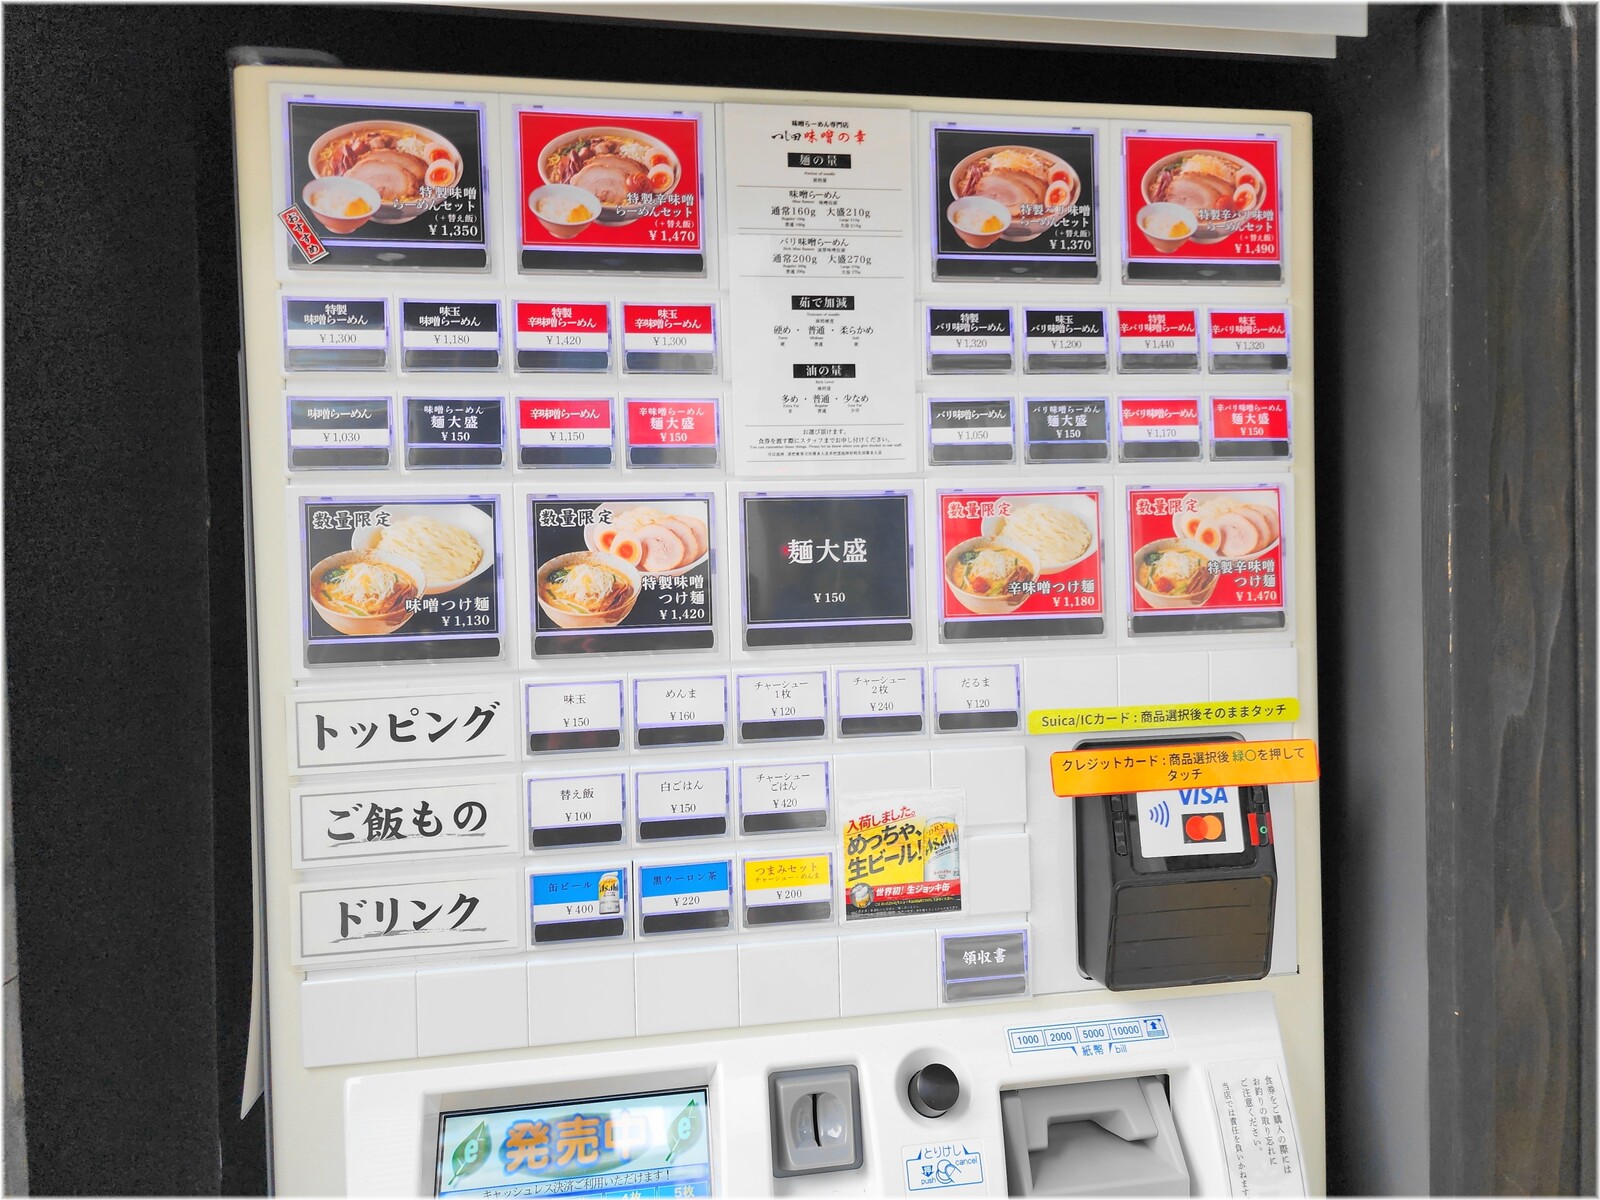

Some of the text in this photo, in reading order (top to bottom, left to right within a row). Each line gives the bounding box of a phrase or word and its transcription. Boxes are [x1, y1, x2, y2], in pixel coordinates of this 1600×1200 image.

[792, 120, 849, 128] 味噌らーめん専門店
[419, 186, 478, 200] 特製味噌
[626, 192, 694, 206] 特製辛味噌
[788, 190, 841, 199] 味噌らーめん
[392, 200, 476, 212] らーめんセット
[615, 206, 693, 218] らーめんセット
[771, 206, 870, 218] 通常160g 大盛210g
[1020, 217, 1090, 228] らーめんセット
[1207, 221, 1274, 232] らーめんセット
[287, 212, 320, 255] おすすめ
[780, 238, 849, 246] バリ味噌らーめん
[772, 254, 872, 265] 通常200g 大盛270g
[800, 296, 848, 309] 茹で加減
[325, 304, 348, 316] 特製
[439, 305, 460, 316] 味玉
[552, 307, 572, 318] 特製
[658, 309, 678, 320] 味玉
[304, 314, 368, 326] 味噌らーめん
[419, 315, 481, 326] 味噌らーめん
[528, 316, 597, 328] 辛味噌らーめん
[634, 318, 702, 330] 辛味噌らーめん
[960, 312, 979, 324] 特製
[1055, 314, 1074, 325] 味玉
[1148, 314, 1166, 324] 特製
[1238, 316, 1256, 326] 味玉
[773, 325, 874, 334] 硬め 普通 柔らかめ
[935, 322, 1006, 332] バリ味噌らーめん
[1030, 324, 1100, 334] バリ味噌らーめん
[1120, 322, 1195, 334] 辛バリ味噌らーめん
[1212, 324, 1284, 335] 辛バリ味噌らーめん
[782, 394, 869, 404] 多め 普通 少なめ
[307, 408, 372, 420] 味噌らーめん
[423, 405, 484, 415] 味噌らーめん
[530, 408, 600, 420] 辛味噌らーめん
[638, 407, 704, 416] 辛味噌らーめん
[1032, 404, 1100, 414] バリ味噌らーめん
[1122, 408, 1198, 419] 辛バリ味噌らーめん
[1216, 404, 1283, 412] 辛バリ味噌らーめん
[936, 410, 1006, 421] バリ味噌らーめん
[948, 501, 1012, 518] 数量限定
[1136, 498, 1199, 516] 数量限定
[312, 510, 392, 530] 数量限定
[539, 508, 613, 527] 数量限定
[788, 538, 868, 564] 麺大盛
[1208, 560, 1276, 574] 特製辛味噌
[641, 576, 704, 590] 特製味噌
[1234, 574, 1276, 588] つけ麺
[1008, 580, 1095, 595] 辛味噌つけ麺
[658, 590, 705, 605] つけ麺
[405, 596, 490, 614] 味噌つけ麺
[754, 680, 808, 691] チャーシュー
[854, 676, 906, 686] チャーシュー
[962, 677, 990, 688] だるま
[666, 688, 696, 699] めんま
[775, 689, 792, 700] 1枚
[872, 685, 888, 694] 2枚
[563, 694, 586, 704] 味玉
[315, 701, 500, 751] トッピング
[756, 773, 810, 784] チャーシュー
[1167, 769, 1202, 782] タッチ
[660, 780, 704, 792] 白ごはん
[770, 782, 797, 792] ごはん
[560, 788, 594, 800] 替え飯
[1178, 788, 1228, 806] VISA
[327, 800, 488, 842] ご飯もの
[847, 806, 916, 834] 入荷しました。
[848, 822, 922, 856] めっちゃ、
[756, 862, 817, 876] つまみセット
[653, 870, 718, 886] 黒ウーロン茶
[548, 882, 592, 892] 缶ビール
[907, 882, 950, 895] 生ジョッキ缶
[338, 893, 480, 938] ドリンク
[962, 947, 1006, 966] 領収書
[1082, 1028, 1104, 1039] 5000
[1112, 1025, 1140, 1036] 10000
[1017, 1034, 1040, 1045] 1000
[1050, 1032, 1072, 1042] 2000
[1082, 1044, 1104, 1057] 紙幣
[1114, 1044, 1128, 1054] bill
[506, 1110, 648, 1172] 発売中
[924, 1145, 962, 1160] とりけし
[955, 1156, 978, 1166] cancel
[921, 1177, 936, 1186] push
[674, 1185, 695, 1198] 5枚
